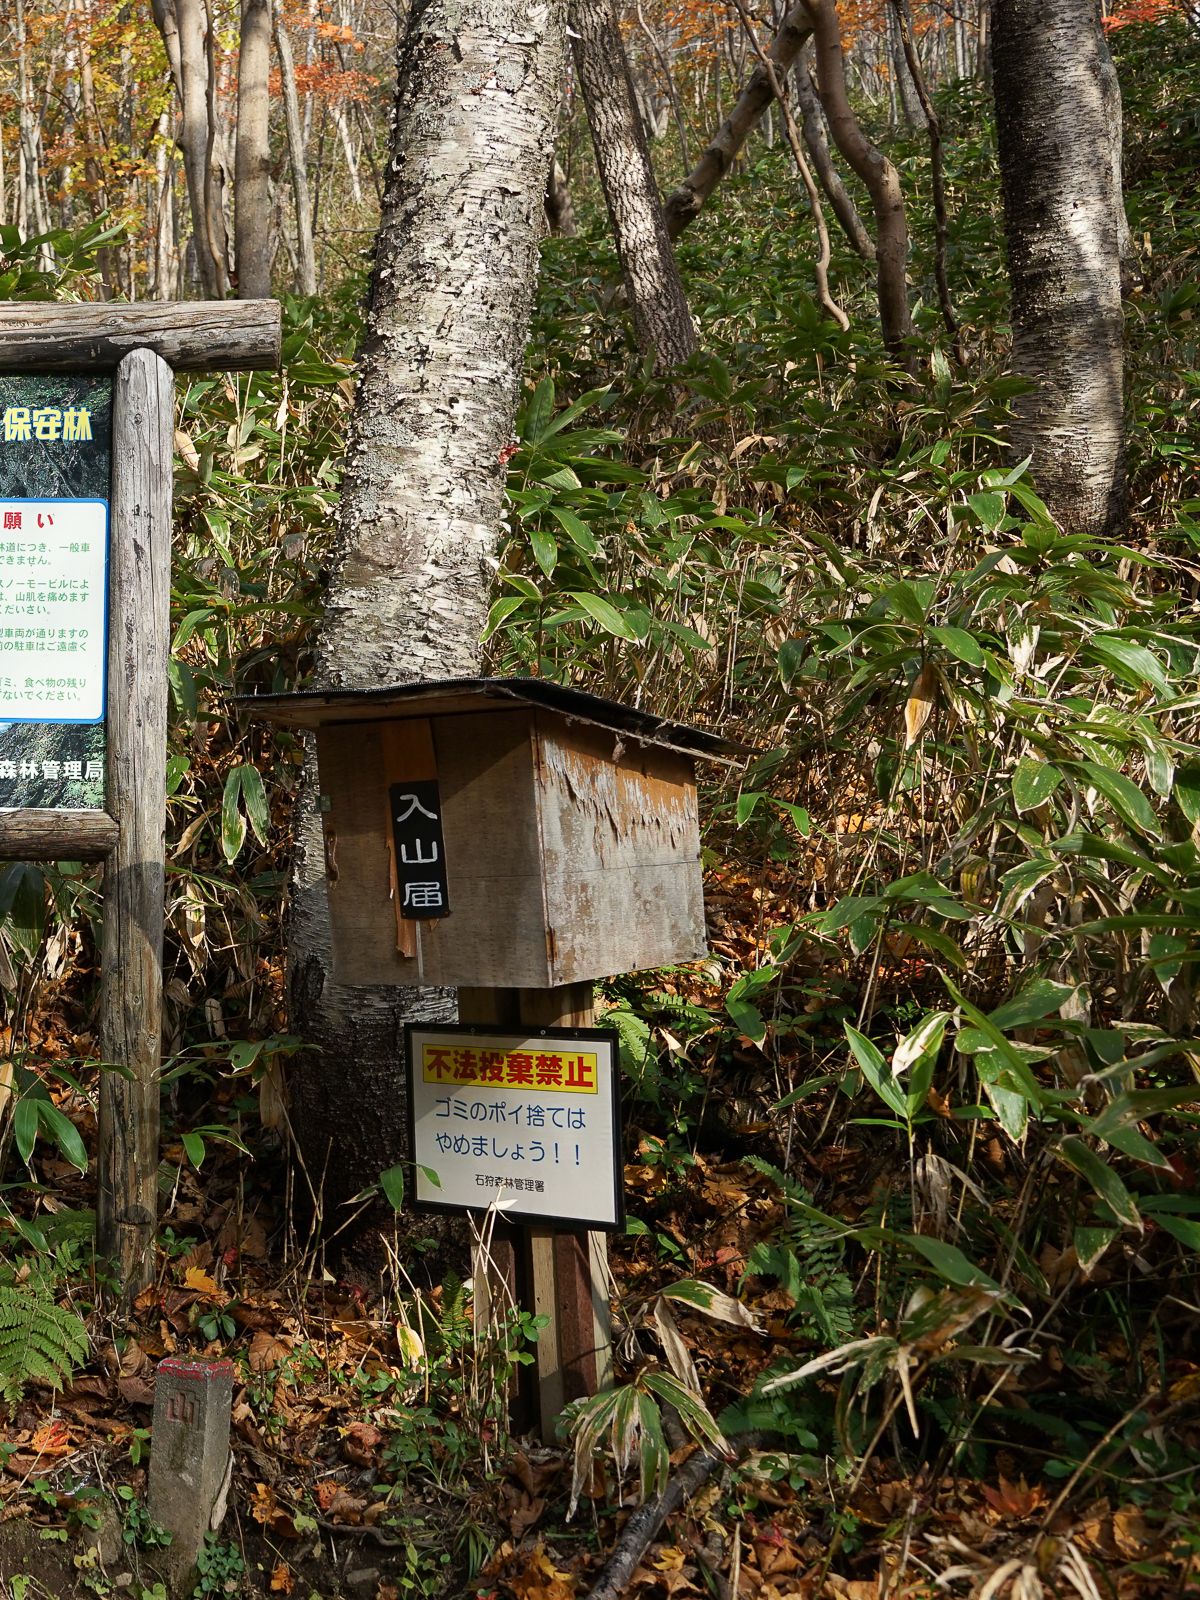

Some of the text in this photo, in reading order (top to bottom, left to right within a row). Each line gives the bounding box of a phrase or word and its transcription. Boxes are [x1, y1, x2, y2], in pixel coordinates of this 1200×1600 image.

[396, 794, 443, 906] 入山届
[426, 1049, 594, 1088] 不法投棄禁止
[435, 1098, 586, 1129] ゴミのポイ捨ては
[435, 1132, 581, 1166] やめましょう！！
